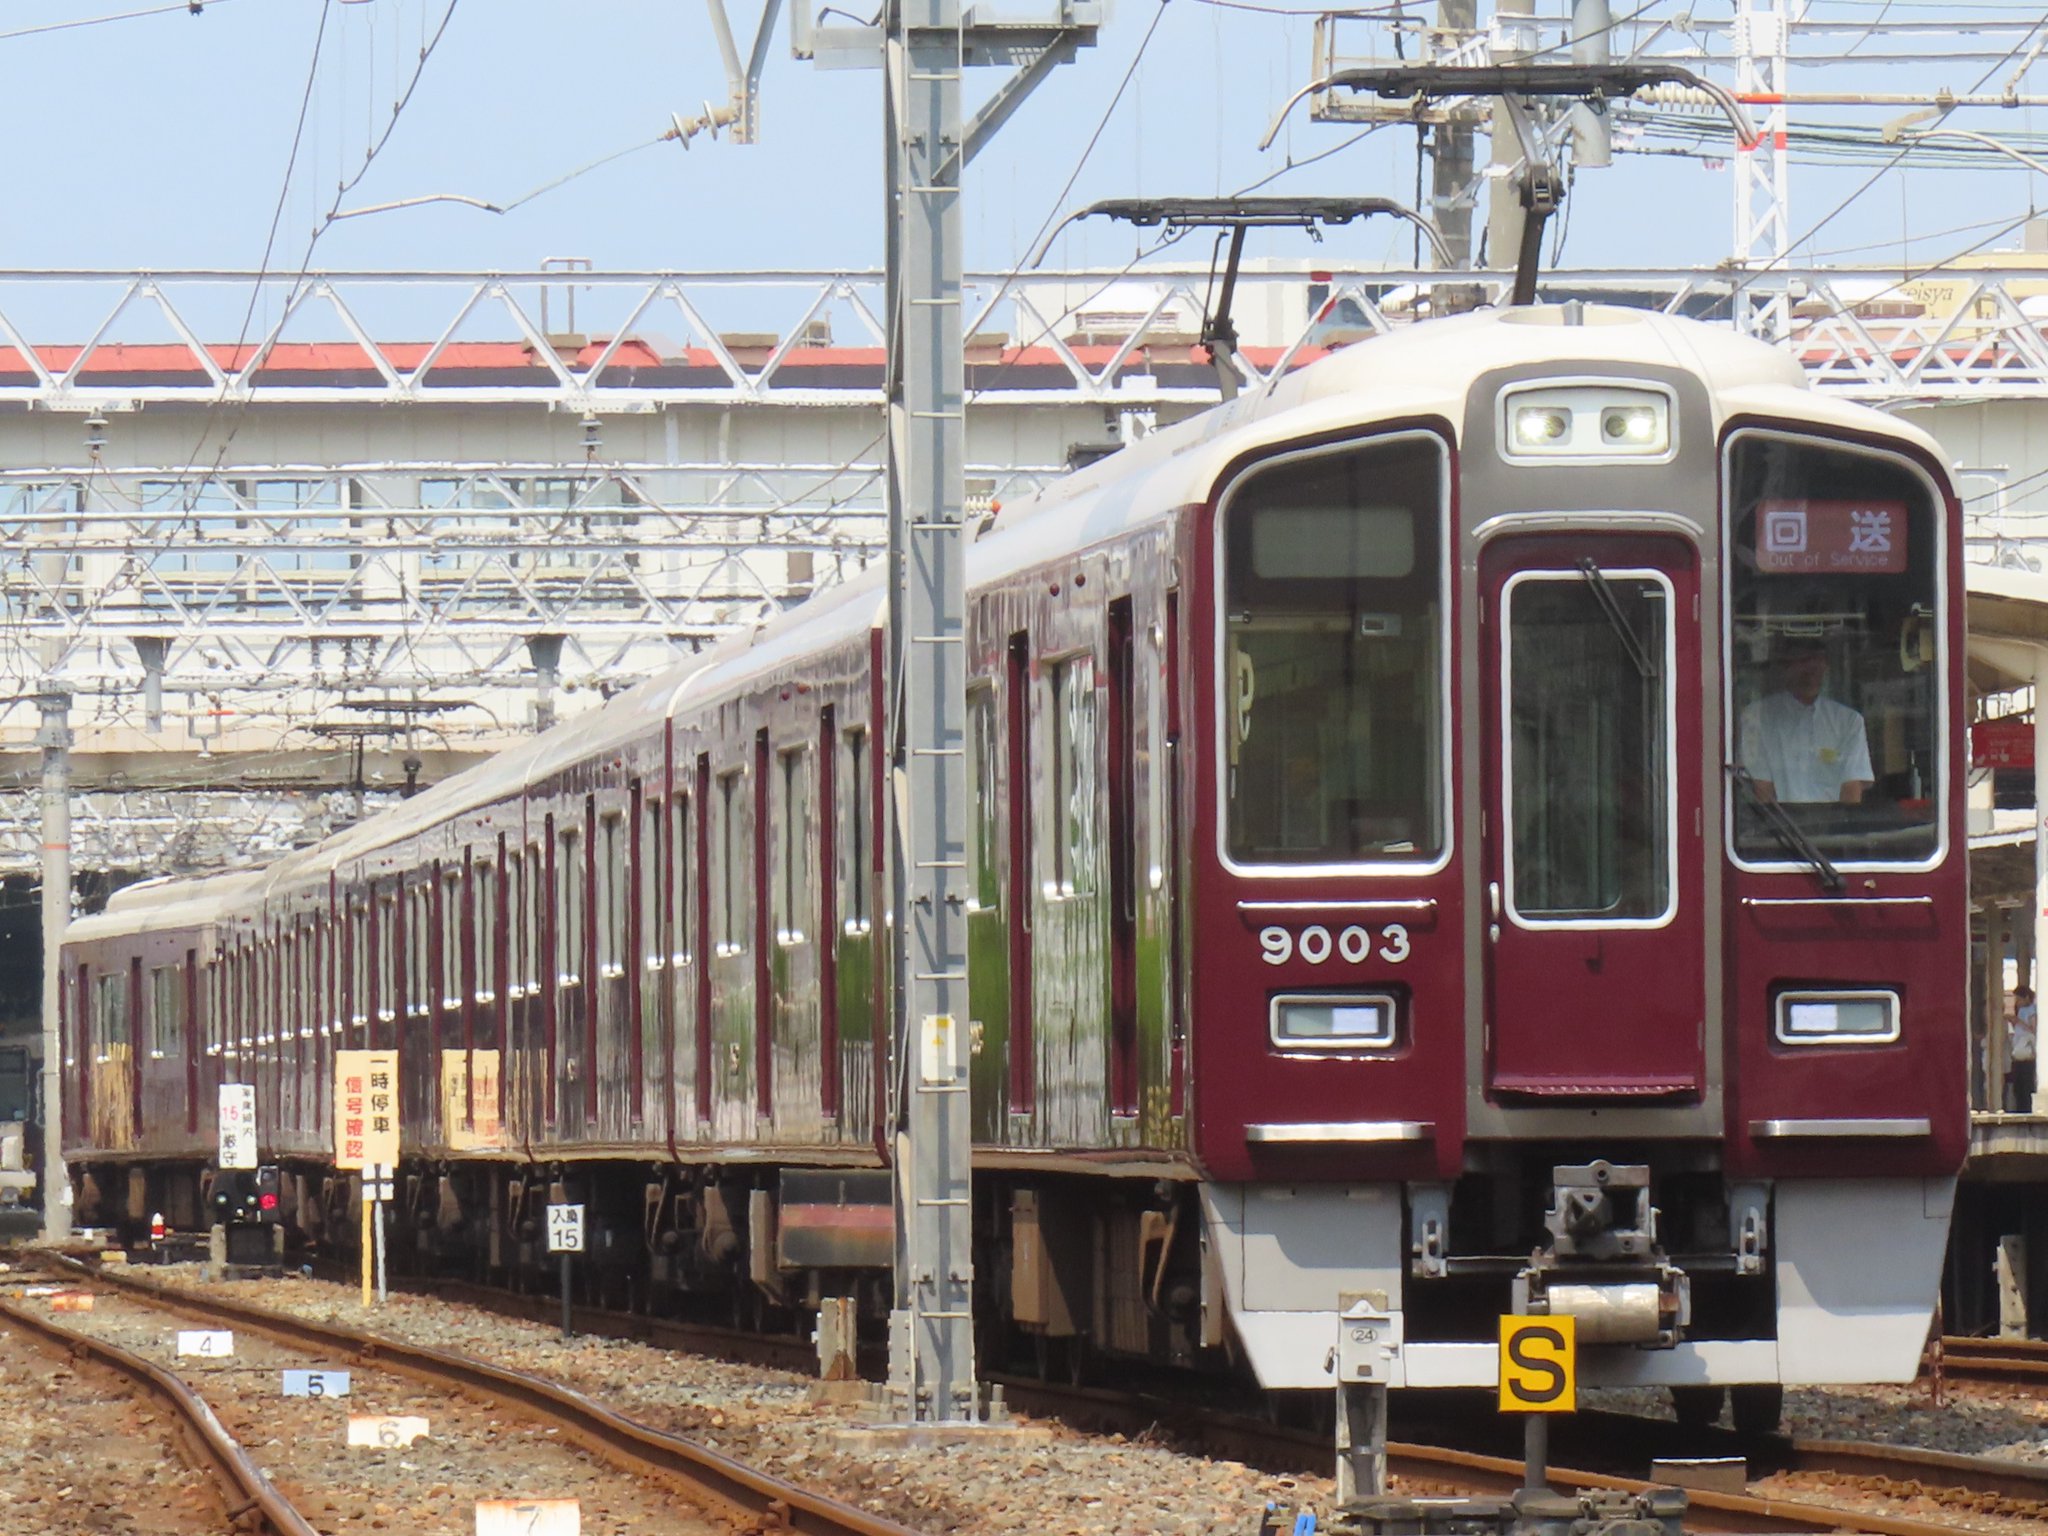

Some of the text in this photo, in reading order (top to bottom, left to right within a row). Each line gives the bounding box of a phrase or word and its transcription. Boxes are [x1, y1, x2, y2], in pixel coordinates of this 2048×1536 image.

[1765, 511, 1892, 552] 回送
[1769, 553, 1889, 566] Out of Service
[1259, 923, 1411, 965] 9003
[370, 1058, 390, 1133] 一時停車
[222, 1105, 239, 1120] 15
[345, 1076, 363, 1158] 信号確認
[553, 1228, 578, 1248] 15
[200, 1335, 212, 1355] 4
[1355, 1329, 1373, 1343] 24
[1508, 1325, 1567, 1403] S
[307, 1374, 324, 1397] 5
[378, 1421, 400, 1446] 6
[513, 1505, 542, 1536] 7
